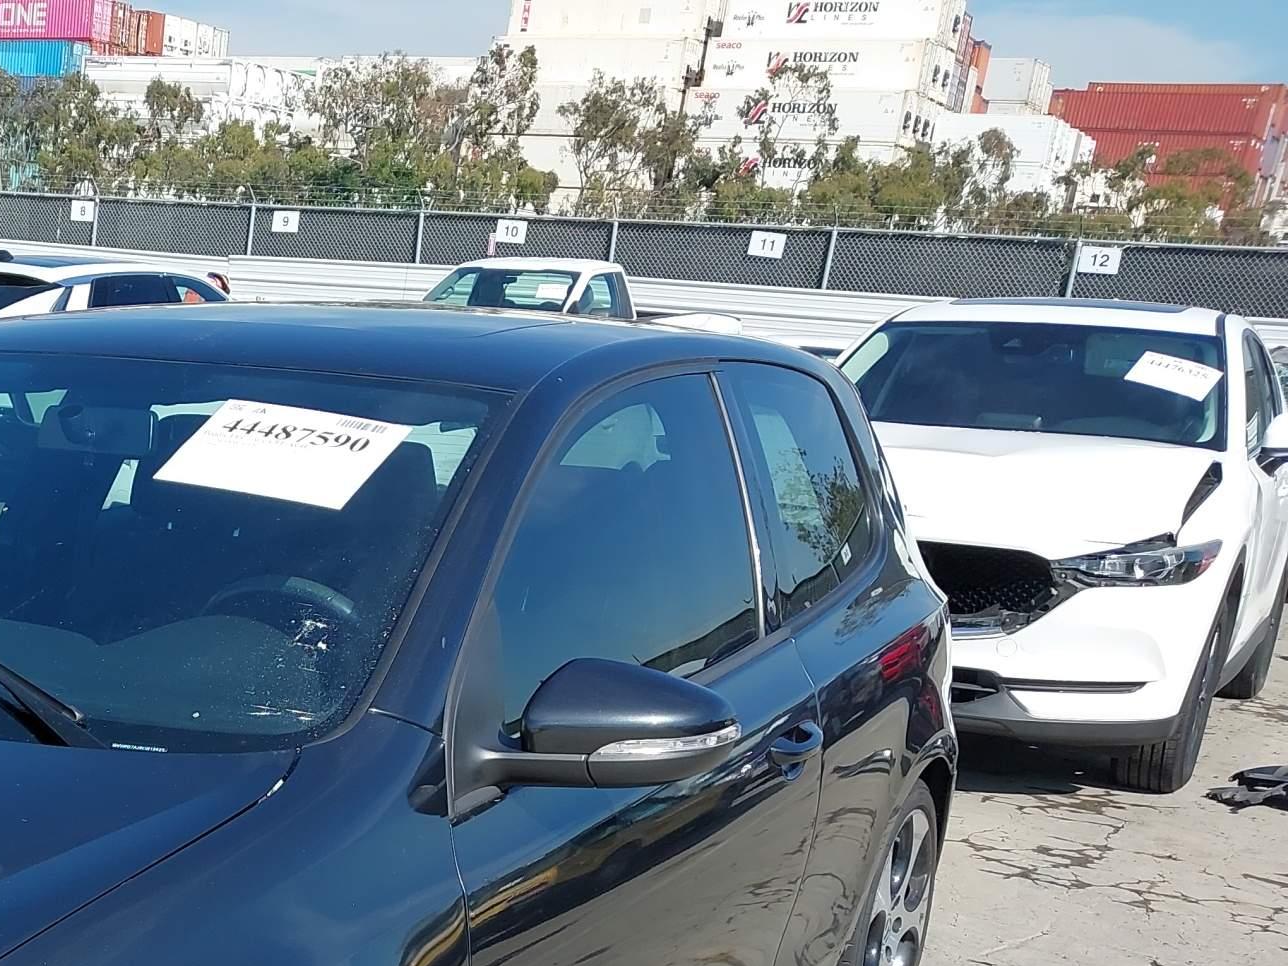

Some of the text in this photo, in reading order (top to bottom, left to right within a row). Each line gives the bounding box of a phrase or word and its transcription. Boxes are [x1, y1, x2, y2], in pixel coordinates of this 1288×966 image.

[812, 2, 880, 13] HORIZON
[792, 51, 860, 63] HORIZON
[771, 102, 838, 114] HORIZON
[80, 206, 86, 216] 8
[282, 216, 289, 226] 9
[504, 224, 519, 238] 10
[760, 238, 776, 251] 11
[1090, 253, 1110, 267] 12
[222, 417, 372, 453] 44487590
